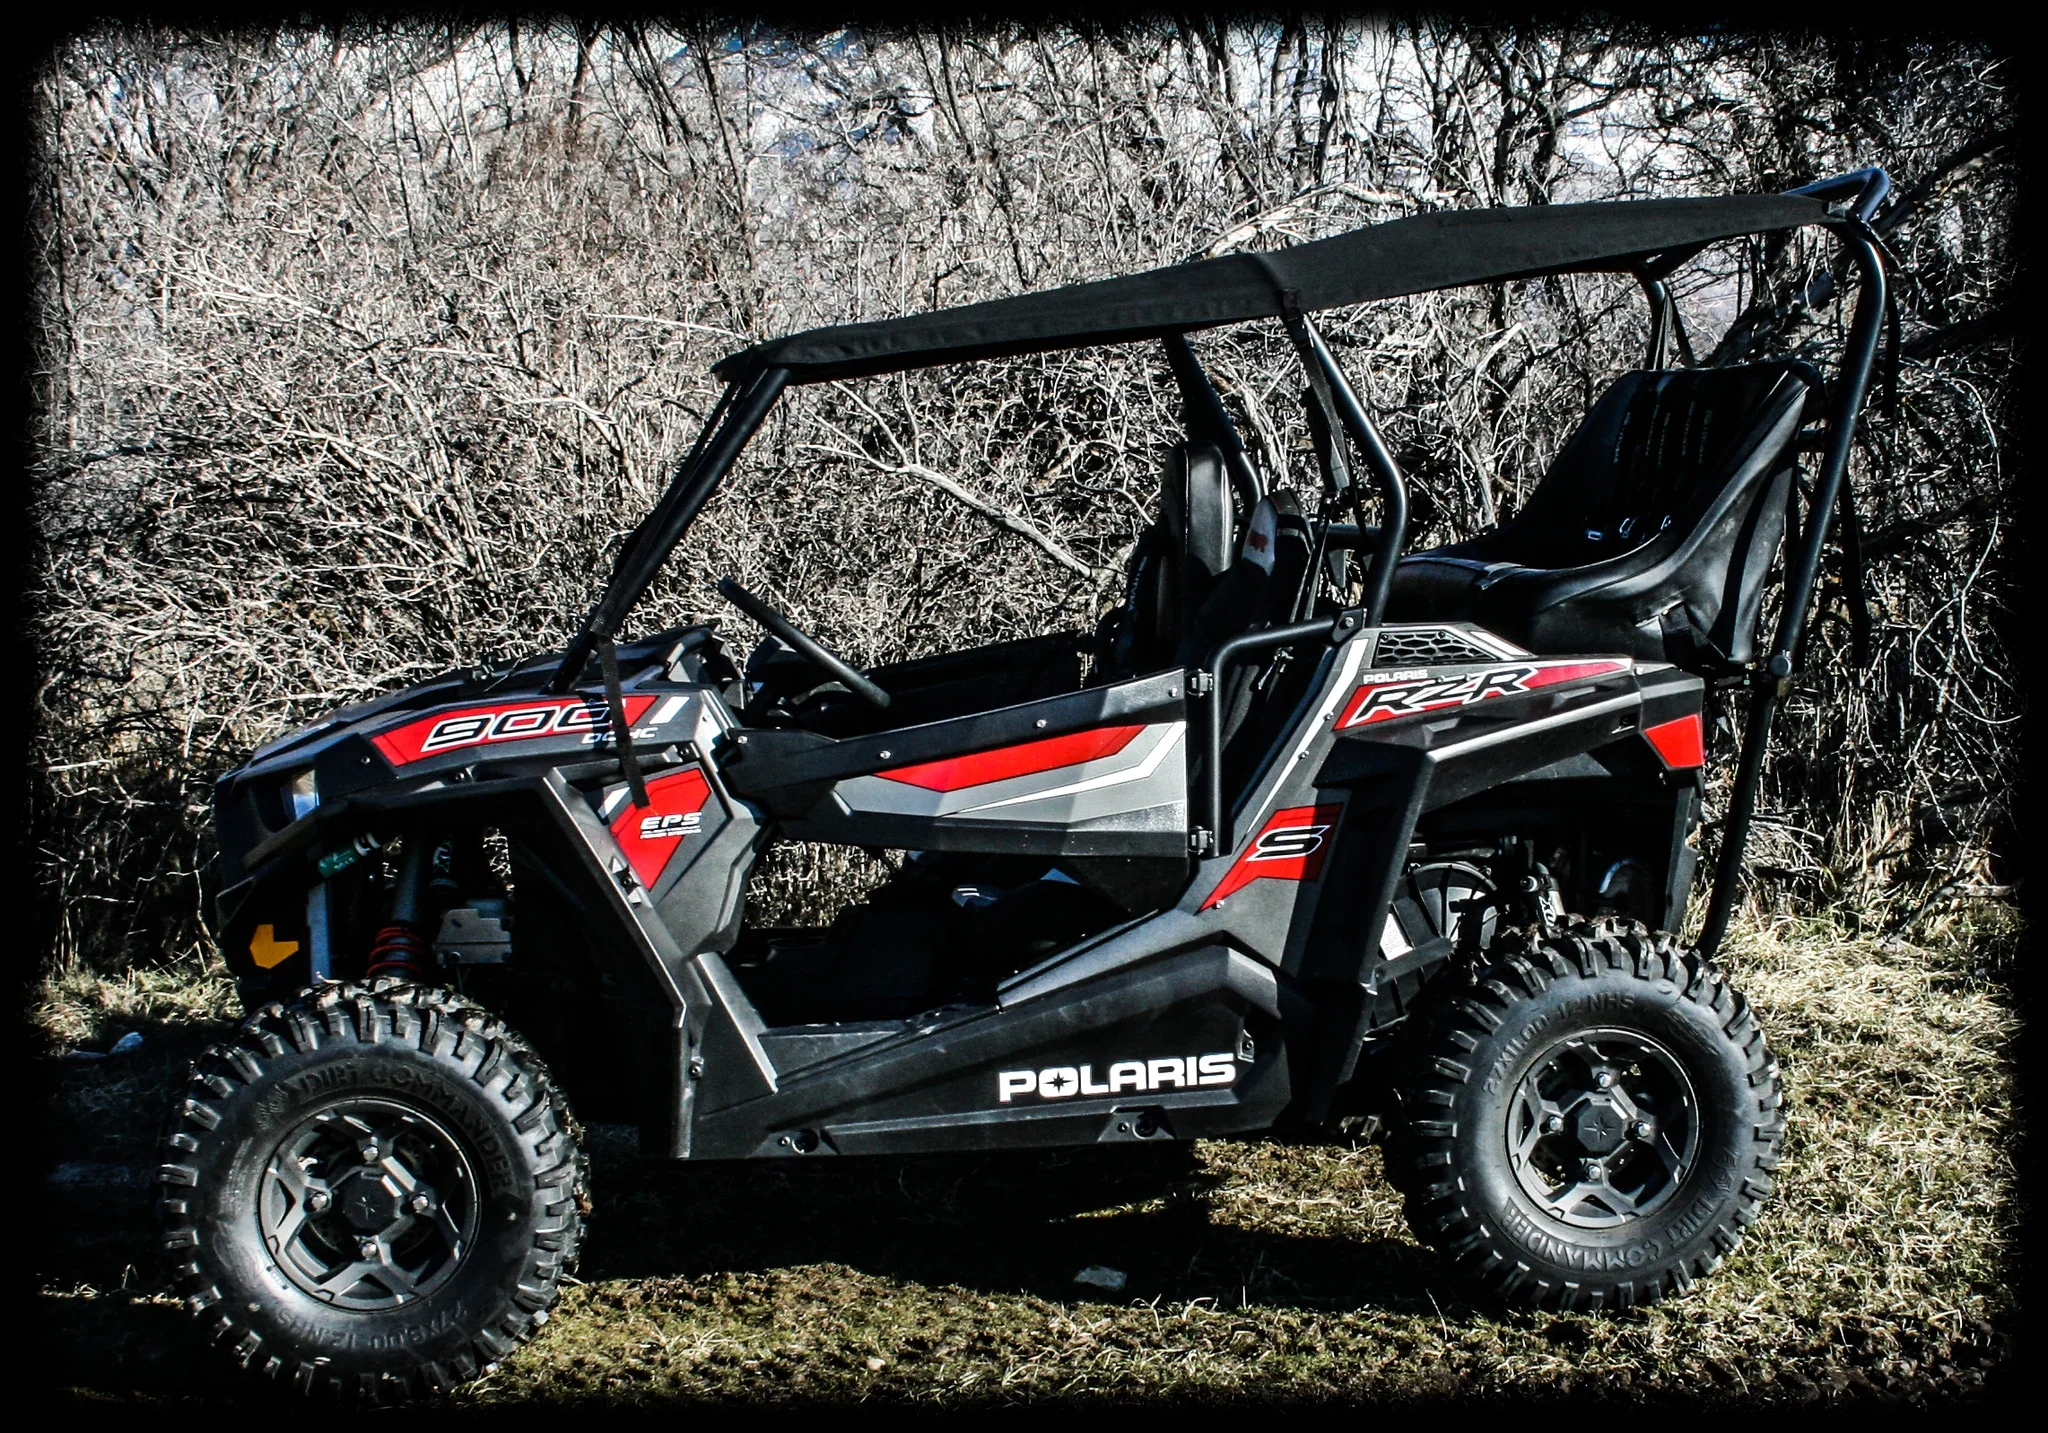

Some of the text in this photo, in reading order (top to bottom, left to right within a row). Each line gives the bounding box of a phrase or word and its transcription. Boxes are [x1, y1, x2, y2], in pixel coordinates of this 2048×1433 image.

[1345, 664, 1539, 728] RZR
[1363, 669, 1429, 685] POLARIS
[640, 811, 702, 830] EPS
[1245, 825, 1332, 861] S
[999, 1052, 1237, 1102] POLARIS
[300, 1063, 512, 1191] DIRT COMMANDER
[1502, 1197, 1716, 1271] DIRT COMMANDER
